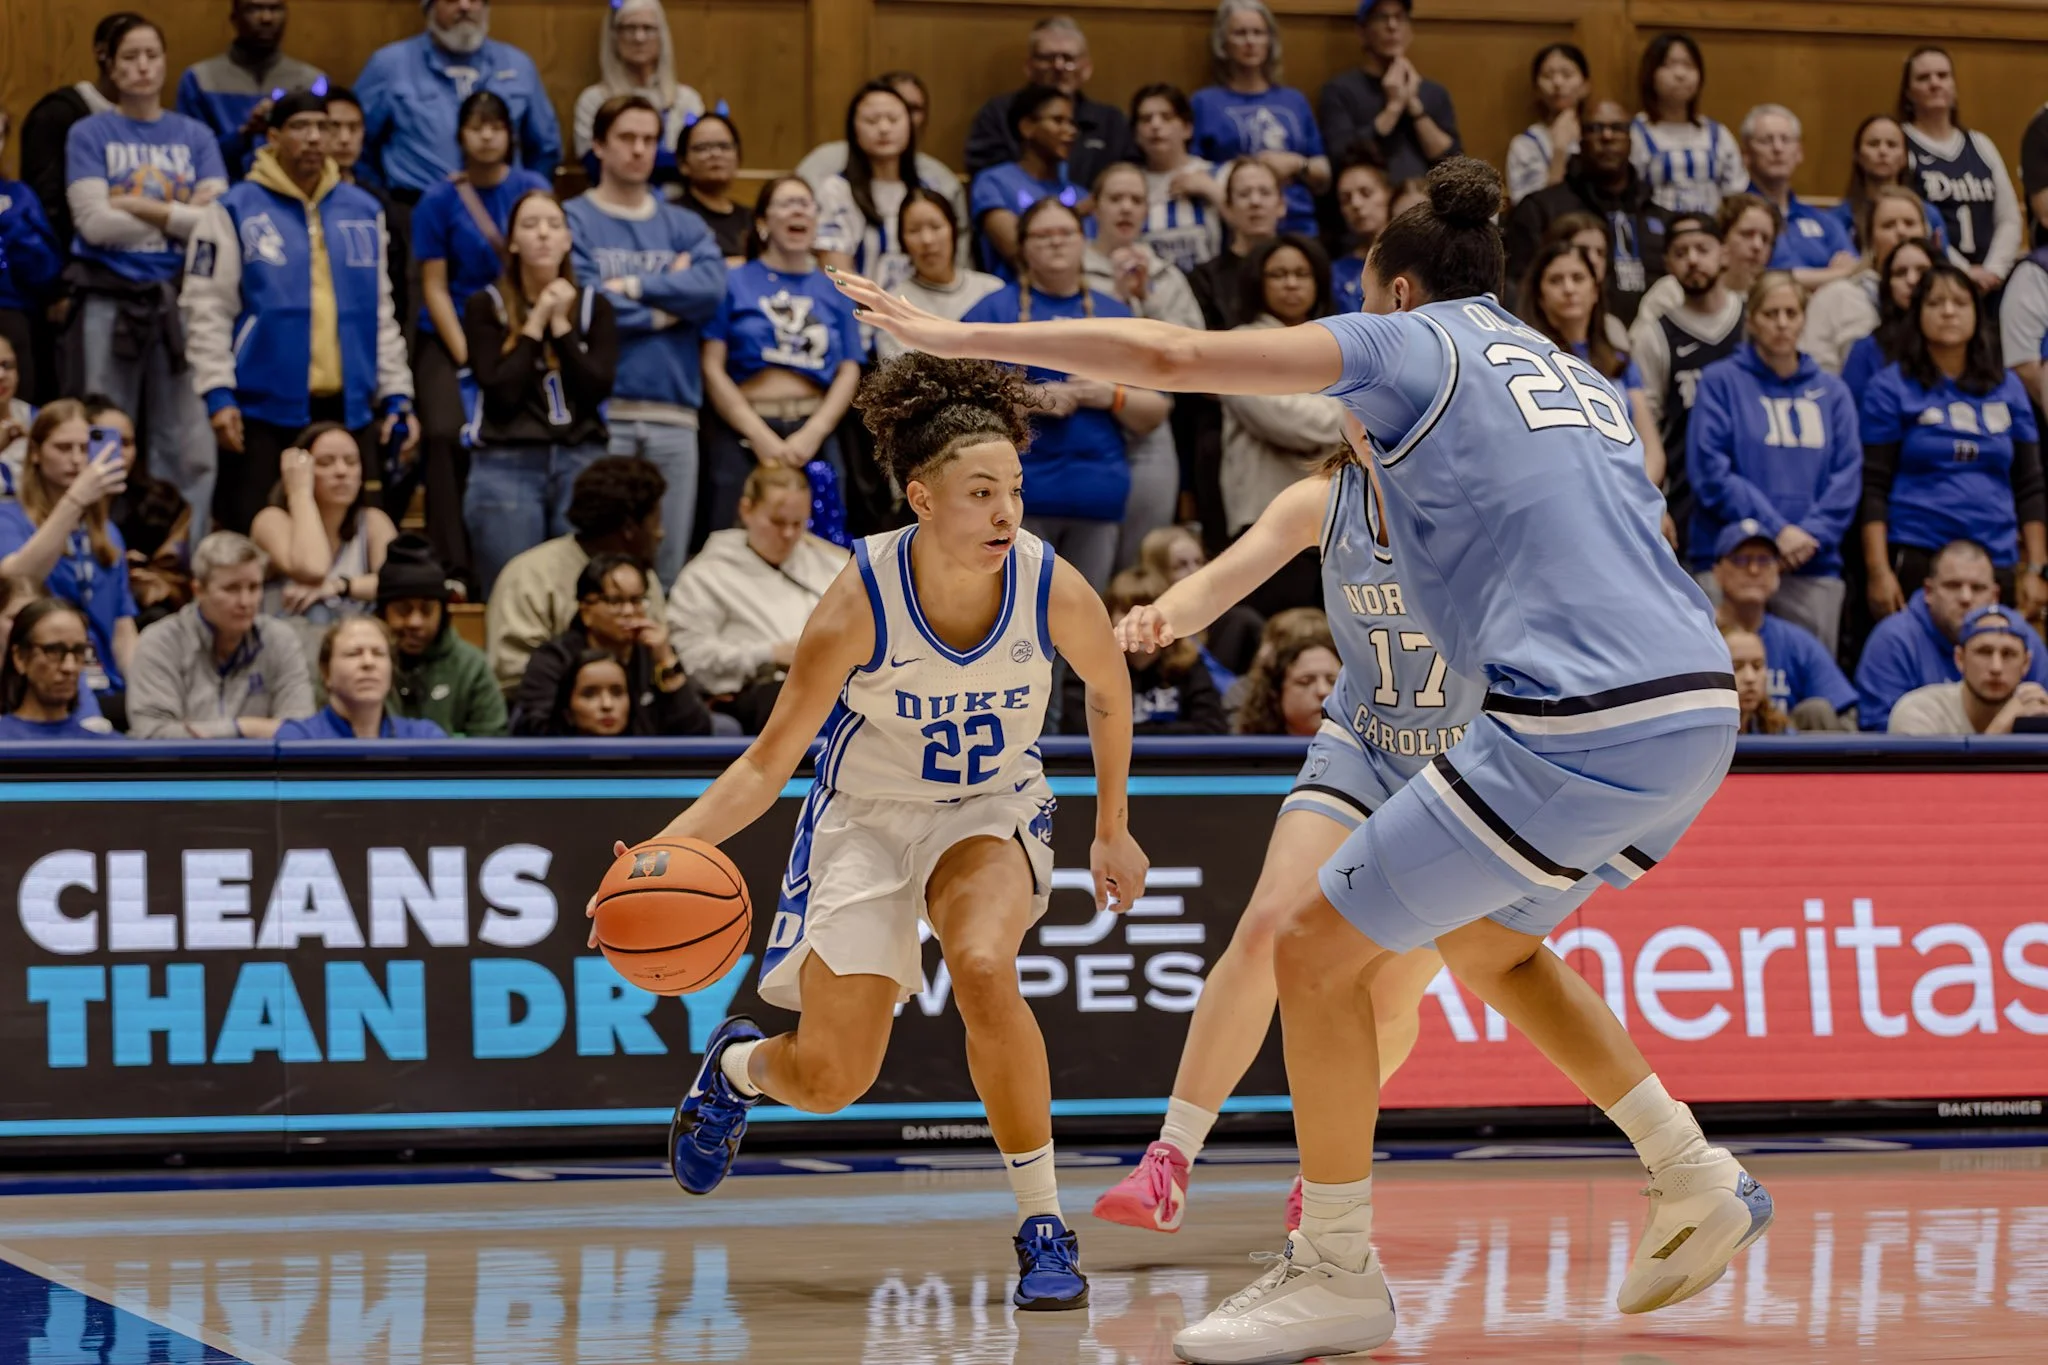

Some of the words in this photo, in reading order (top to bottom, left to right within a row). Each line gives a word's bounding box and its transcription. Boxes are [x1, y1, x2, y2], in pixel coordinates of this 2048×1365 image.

[105, 141, 196, 182] DUKE
[1956, 203, 1977, 253] 1
[542, 370, 572, 426] 1
[1483, 341, 1636, 446] 26
[1342, 582, 1406, 615] NOR
[1368, 628, 1448, 708] 17
[895, 685, 1030, 720] DUKE
[920, 712, 1005, 786] 22
[1353, 703, 1469, 756] CAROLIN
[18, 843, 559, 955] CLEANS
[27, 961, 428, 1068] THAN
[471, 954, 755, 1059] DRY
[901, 1124, 994, 1141] DAKTRON
[1937, 1100, 2042, 1117] DAKTRONICS
